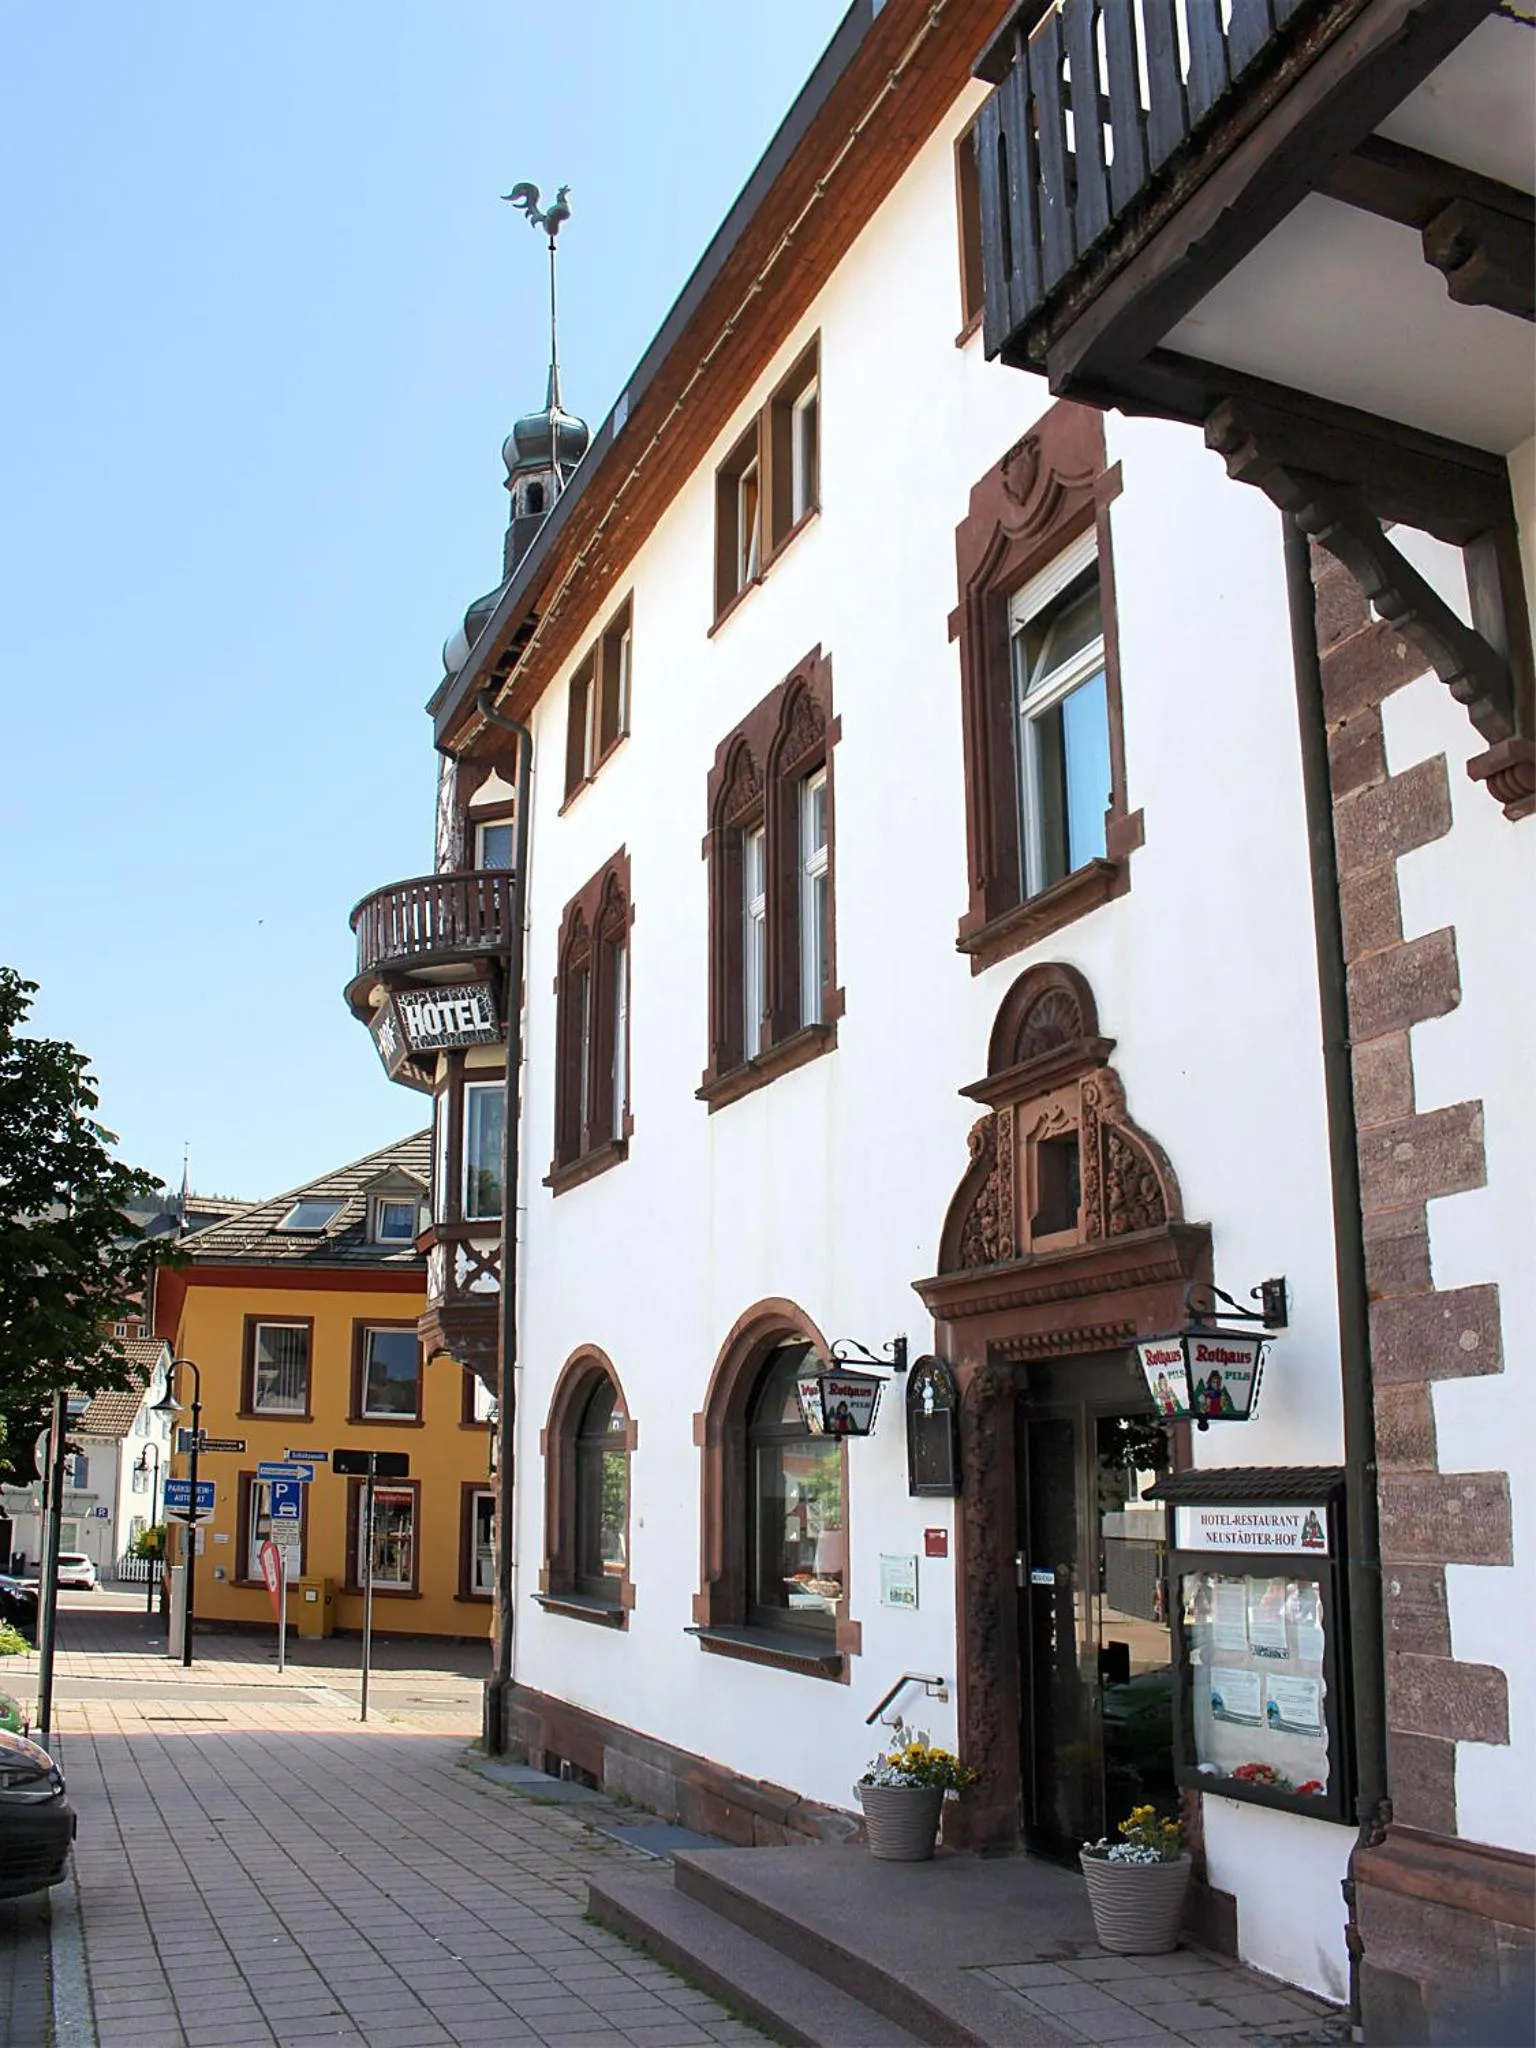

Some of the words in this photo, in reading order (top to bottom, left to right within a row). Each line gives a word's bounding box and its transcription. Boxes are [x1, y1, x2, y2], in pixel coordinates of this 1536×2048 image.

[405, 995, 491, 1037] HOTEL
[1144, 1348, 1182, 1366] Rothaus
[1195, 1344, 1253, 1366] Rothaus
[1224, 1370, 1250, 1381] PILS
[167, 1484, 213, 1494] PARKSEIN-
[276, 1483, 288, 1498] P
[174, 1494, 205, 1503] AUTOAT
[1200, 1514, 1300, 1528] HOTEL-RESTAURANT
[1206, 1530, 1298, 1546] NEUSTÄDTER-HOF
